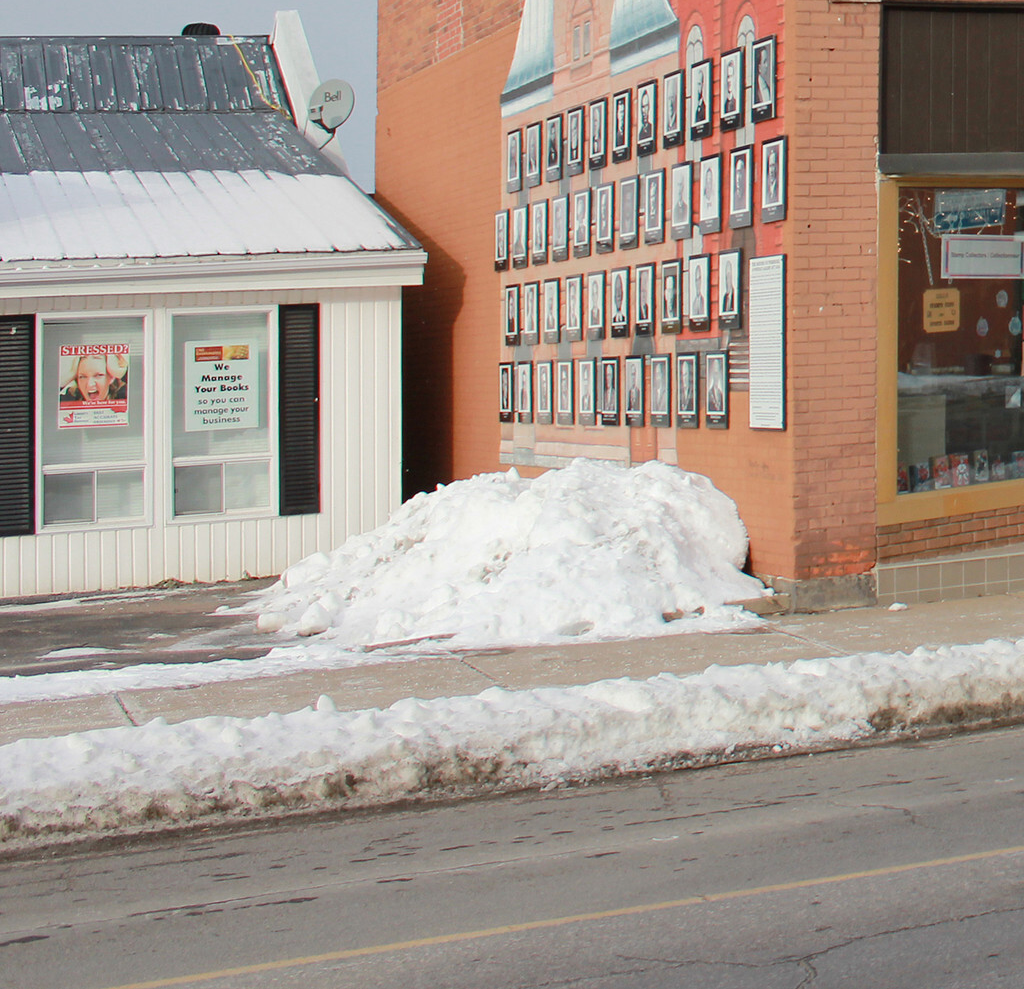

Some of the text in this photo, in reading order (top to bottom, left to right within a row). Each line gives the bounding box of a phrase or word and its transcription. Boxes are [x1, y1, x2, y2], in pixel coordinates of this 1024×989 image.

[324, 90, 341, 102] Bell
[62, 344, 129, 355] STRESSED?
[201, 374, 243, 382] Manage
[195, 383, 249, 393] Your Books
[194, 406, 249, 415] manage your
[202, 416, 241, 424] business
